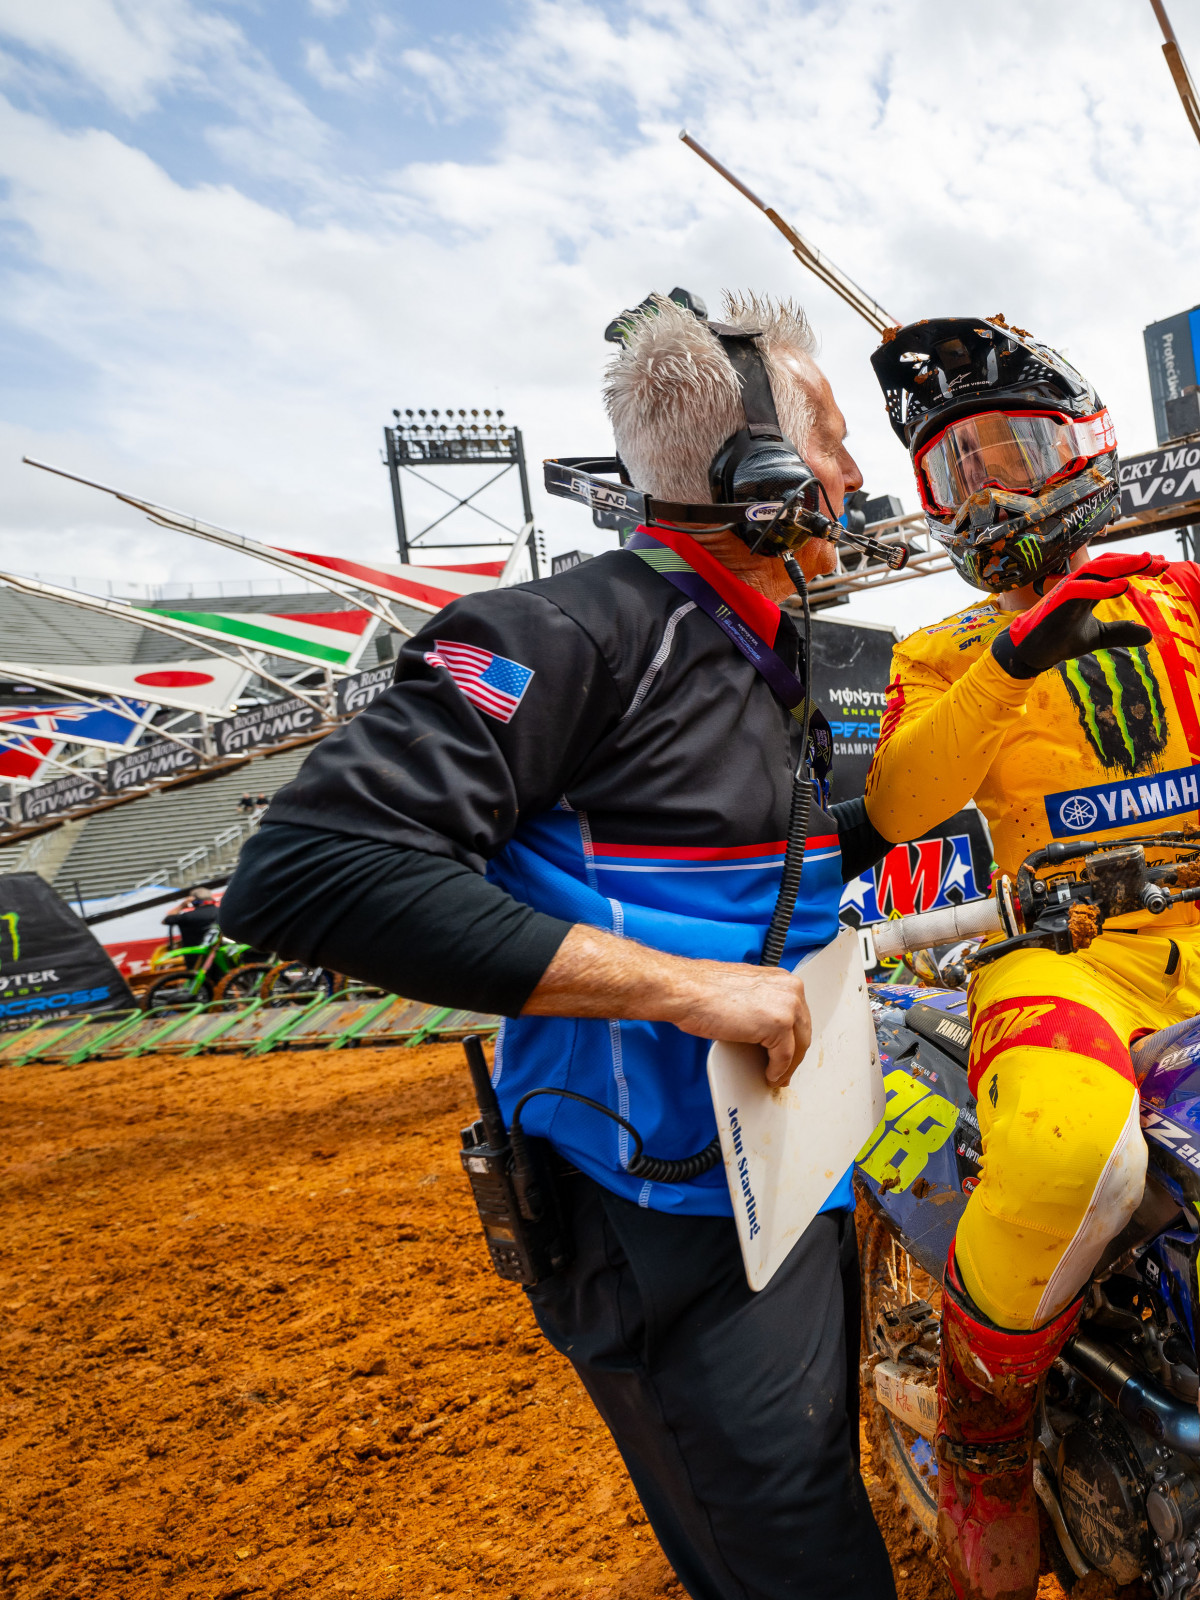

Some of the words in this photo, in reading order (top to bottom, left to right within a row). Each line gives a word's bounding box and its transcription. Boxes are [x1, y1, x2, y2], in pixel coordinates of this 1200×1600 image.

[1162, 332, 1181, 400] Protective
[1119, 457, 1158, 484] CKY
[572, 479, 627, 508] STARLING
[1065, 484, 1116, 528] MONSTER
[554, 557, 579, 576] AMA
[359, 666, 394, 687] ROCKY
[829, 687, 887, 706] MONSTE
[233, 711, 263, 729] ROCKY
[262, 698, 309, 720] MOUNTAI
[842, 707, 882, 716] ENERG
[125, 750, 149, 767] ROCKY
[935, 1018, 972, 1047] YAMAHA
[968, 1003, 1057, 1067] HOR
[965, 1146, 982, 1165] OPTI
[727, 1106, 744, 1156] John
[737, 1156, 761, 1241] Starling
